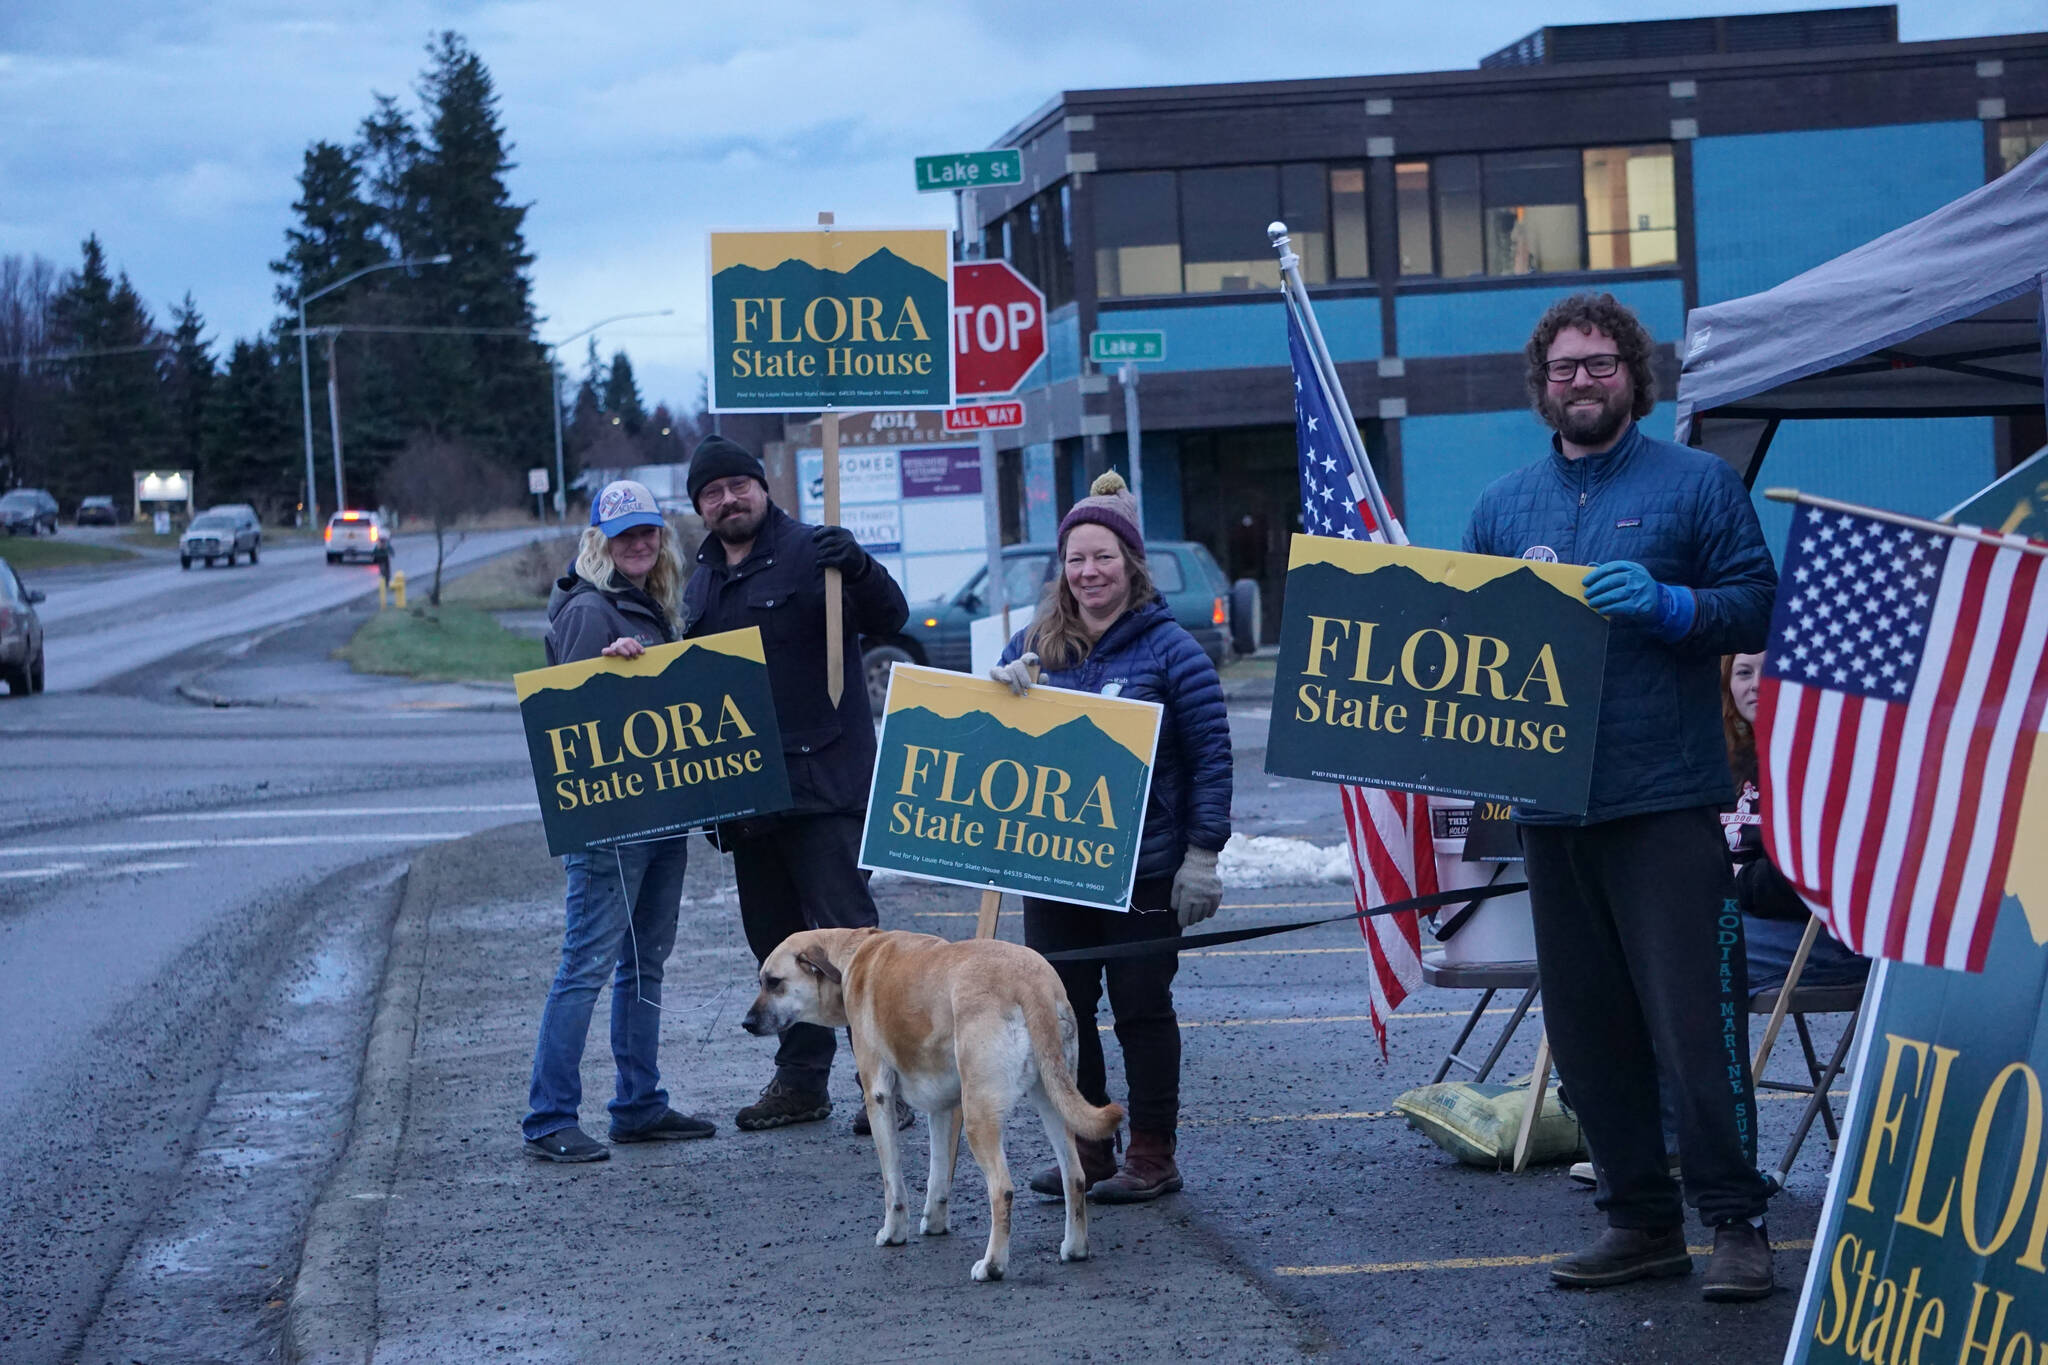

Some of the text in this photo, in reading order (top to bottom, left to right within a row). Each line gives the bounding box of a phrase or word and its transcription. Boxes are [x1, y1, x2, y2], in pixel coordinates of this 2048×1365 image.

[927, 161, 1009, 183] Lake St
[731, 296, 931, 343] FLORA
[954, 302, 1036, 354] TOP
[1100, 338, 1137, 355] Lake
[732, 347, 932, 378] State House
[841, 432, 875, 444] AKE
[871, 412, 918, 432] 4014
[952, 407, 1017, 427] ALL WAY
[1300, 615, 1569, 708] FLORA
[545, 693, 756, 776] FLORA
[1295, 683, 1566, 754] State House
[556, 748, 763, 811] State House
[895, 743, 1118, 830] FLORA
[888, 850, 901, 858] Paid
[902, 851, 912, 859] for
[912, 854, 920, 862] by
[921, 856, 937, 864] Louie
[939, 858, 954, 867] Flora
[964, 862, 981, 872] State
[982, 865, 1001, 875] House
[1023, 872, 1042, 881] Sheep
[889, 801, 1115, 869] State House
[1718, 898, 1739, 993] KODIAK
[1719, 1002, 1743, 1095] MARINE
[1847, 1033, 2048, 1274] FLO
[1815, 1233, 1945, 1365] State
